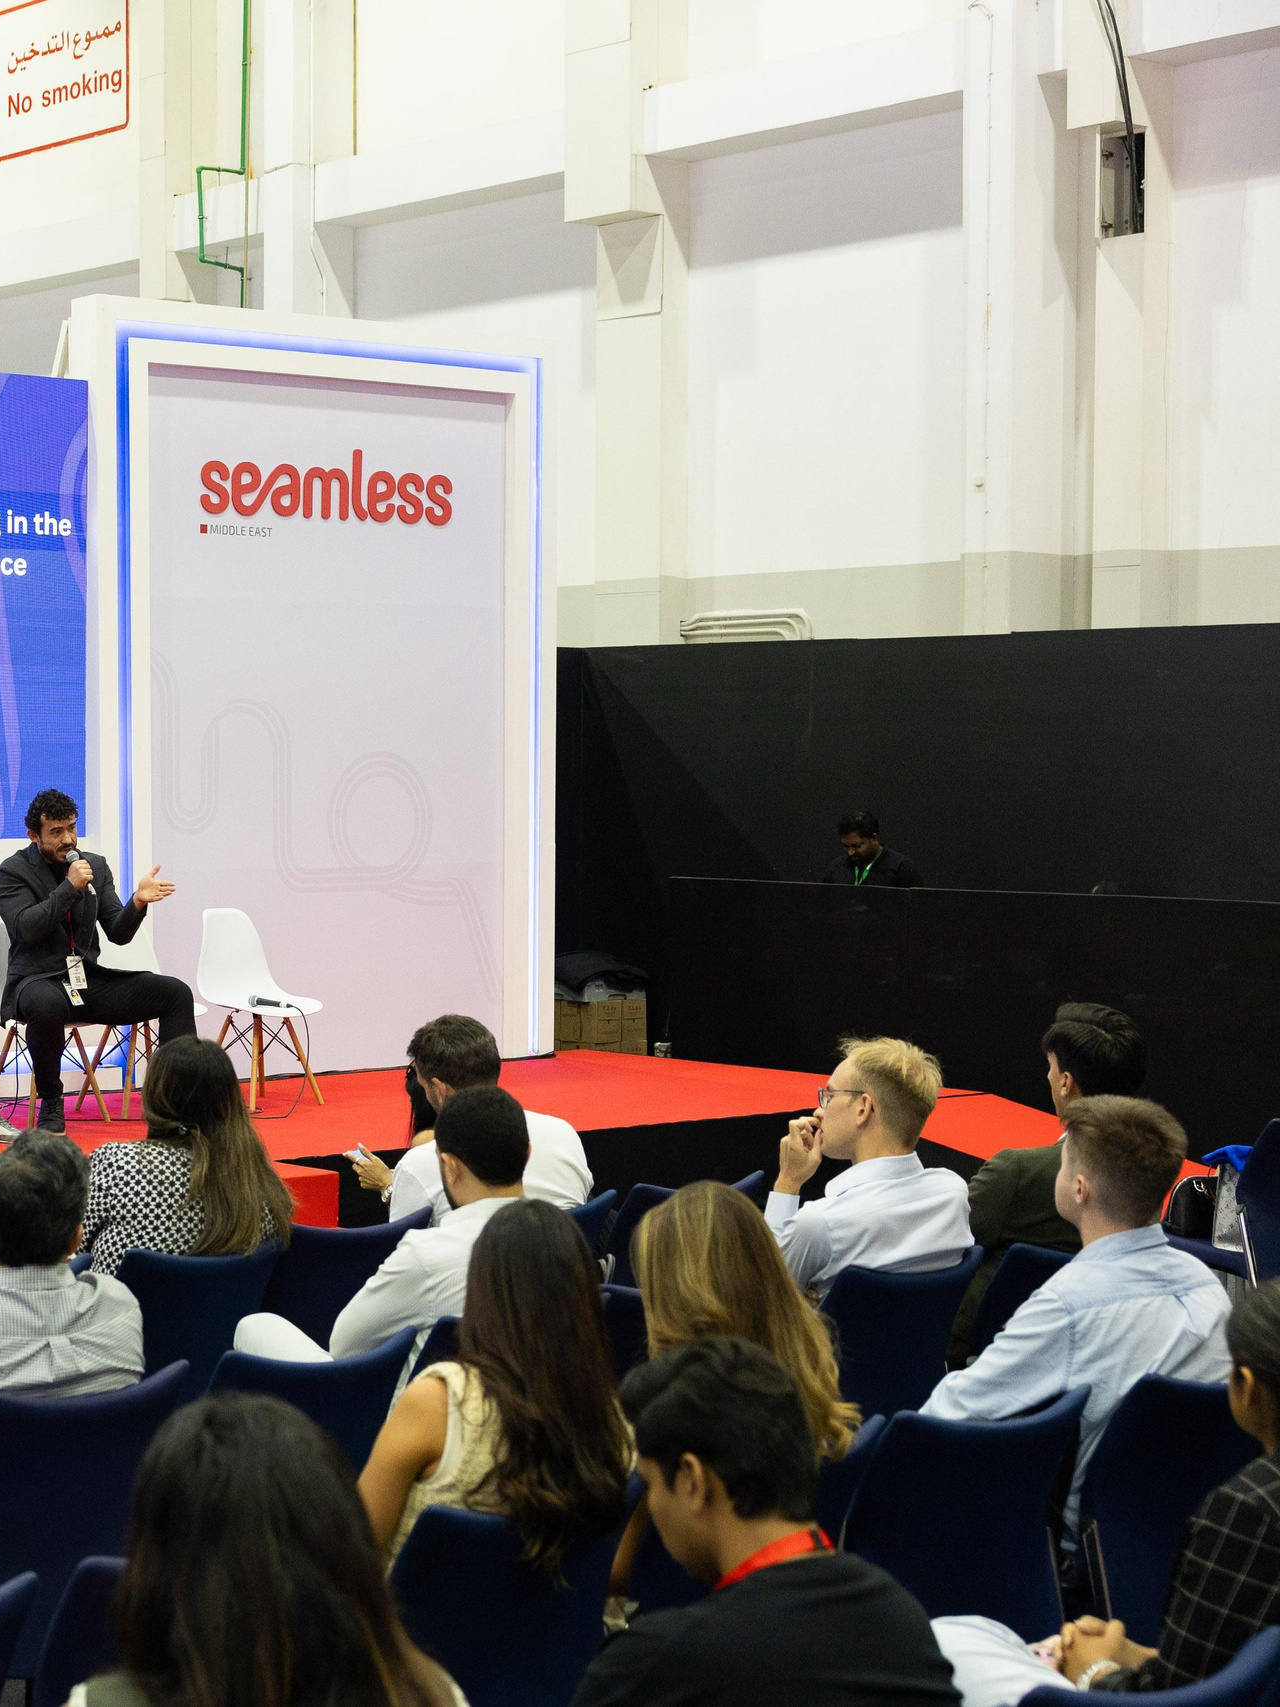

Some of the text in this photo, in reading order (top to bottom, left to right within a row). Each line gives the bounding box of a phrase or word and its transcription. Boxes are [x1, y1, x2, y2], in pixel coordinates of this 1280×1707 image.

[7, 30, 70, 75] التدخين
[8, 69, 122, 117] No smoking
[200, 448, 453, 526] seamless
[6, 509, 28, 534] in
[33, 512, 72, 537] the
[209, 524, 273, 538] MIDDLE EAST
